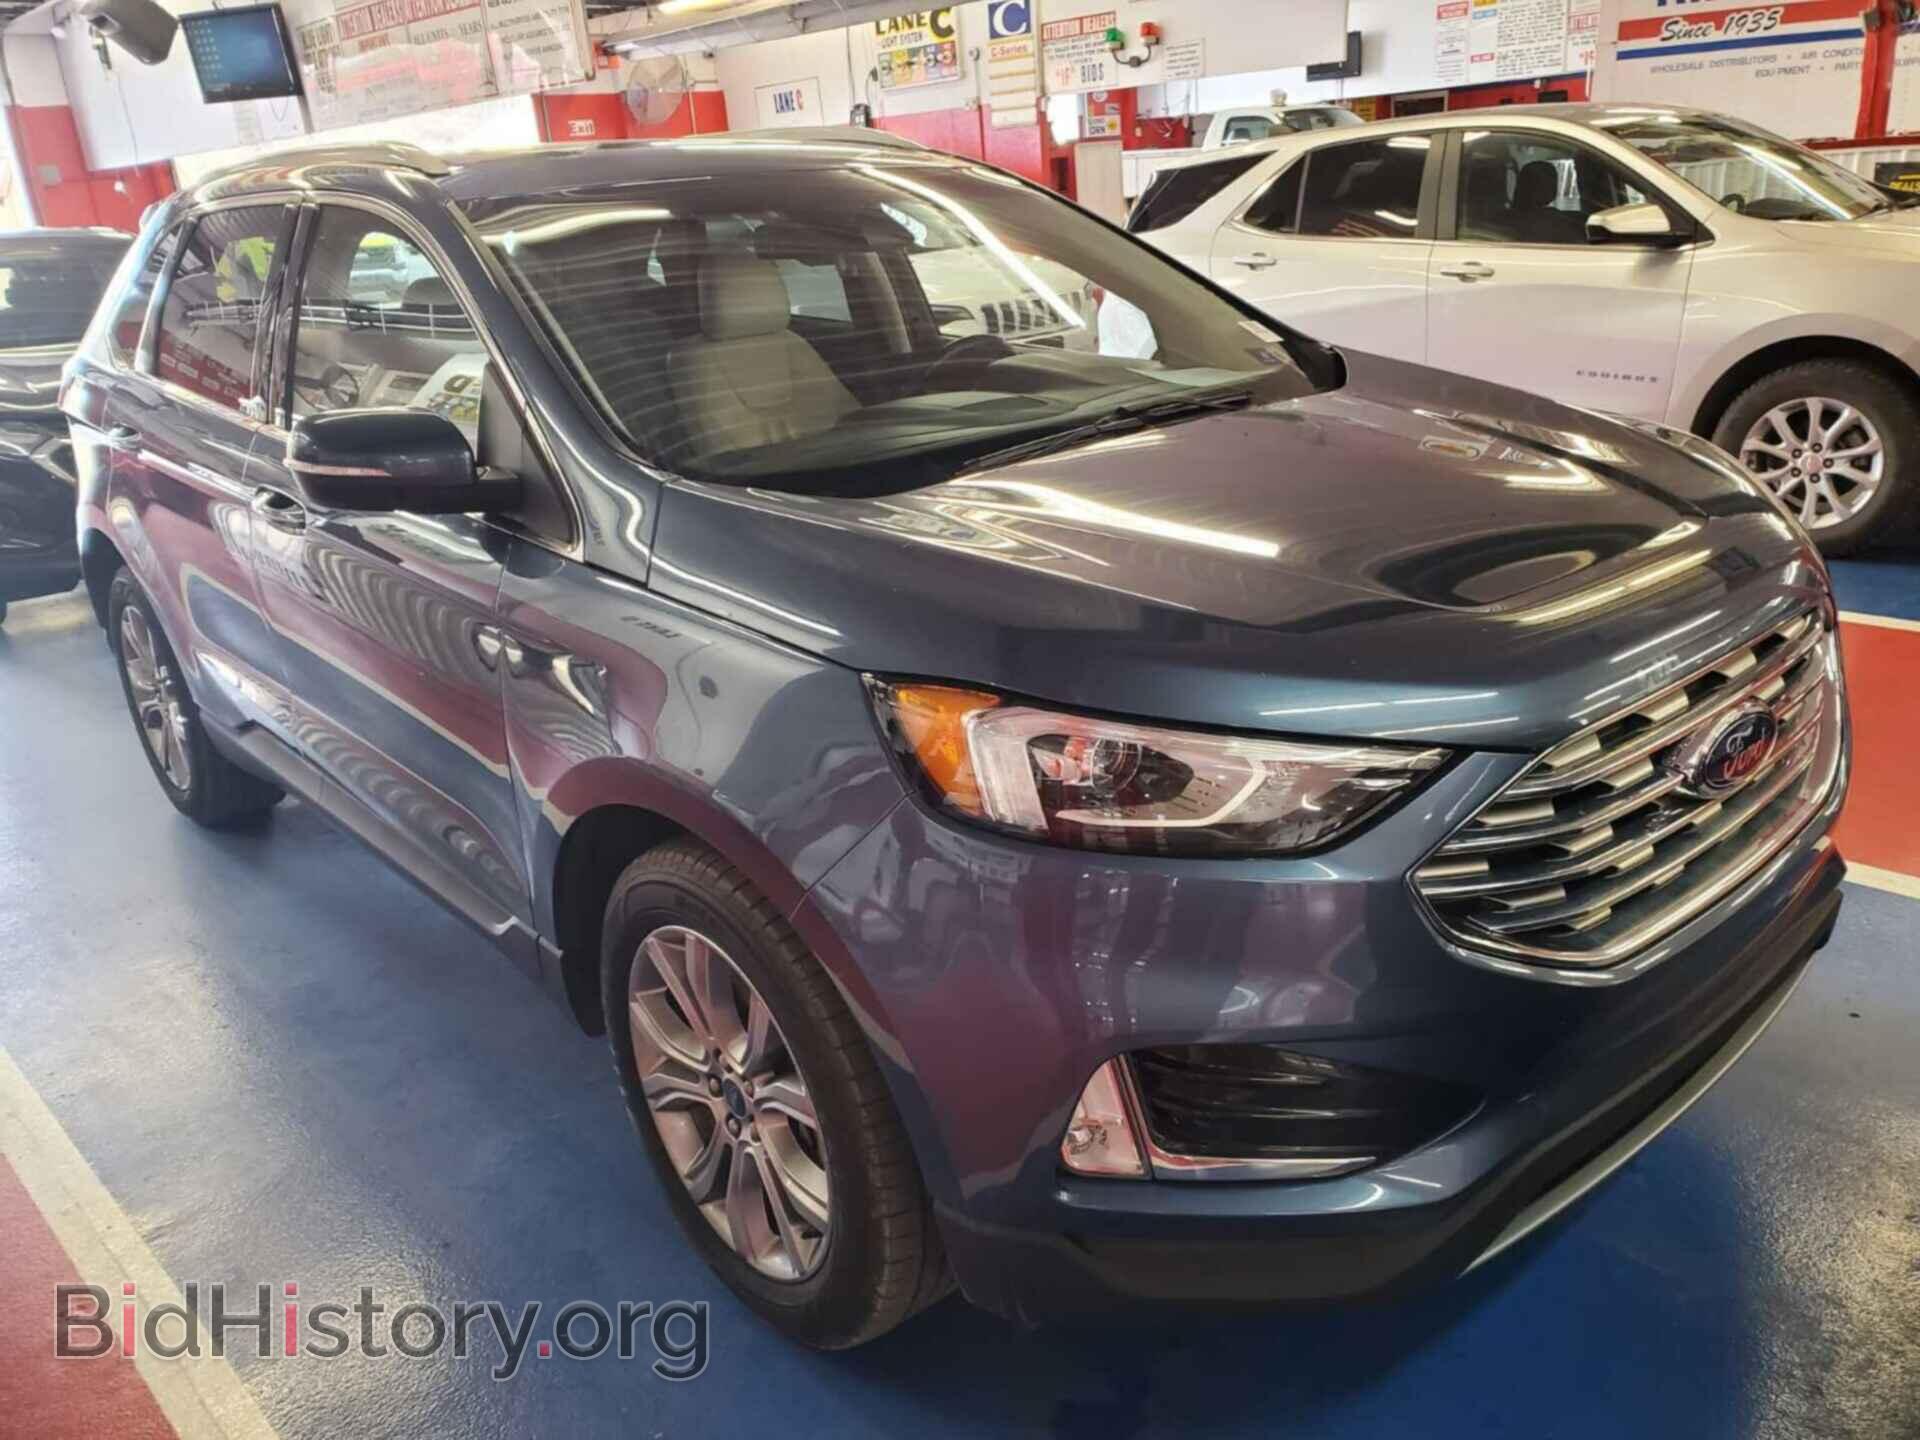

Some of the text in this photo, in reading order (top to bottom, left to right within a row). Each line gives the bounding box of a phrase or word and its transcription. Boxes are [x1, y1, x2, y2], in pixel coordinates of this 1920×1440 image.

[875, 6, 955, 38] LANE C
[993, 1, 1027, 36] C
[1660, 9, 1781, 42] Since 1935
[773, 88, 805, 114] LANE C
[1724, 722, 1767, 780] Ford
